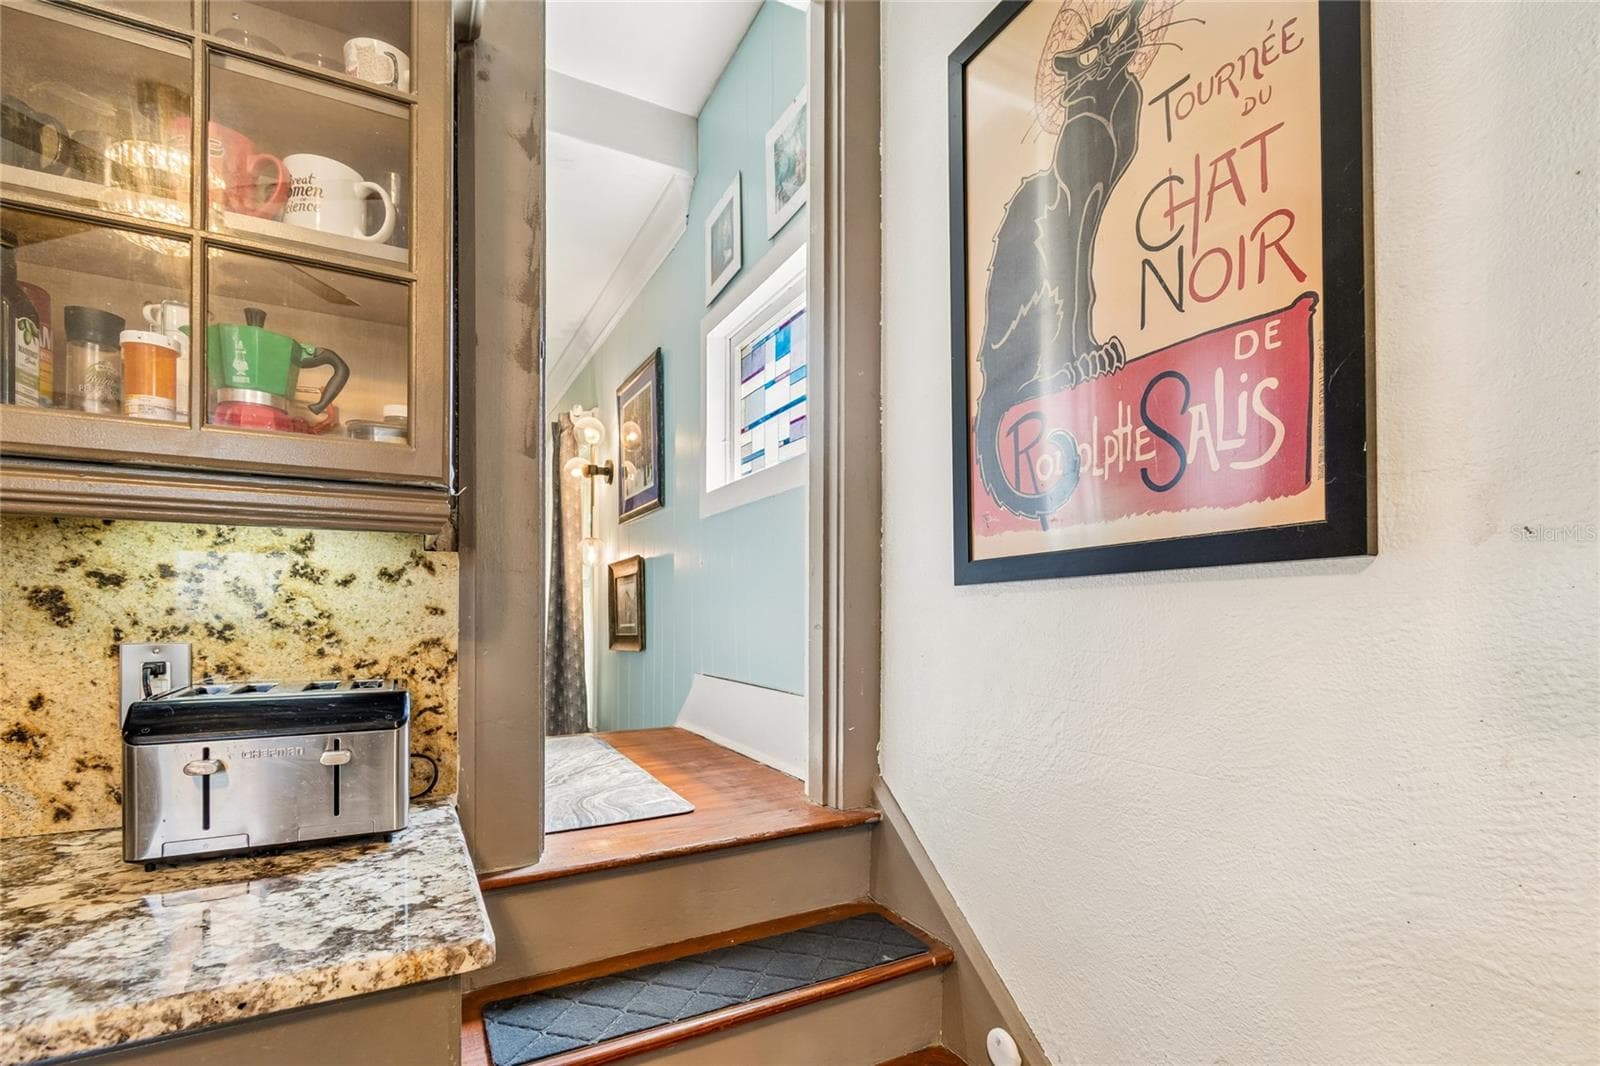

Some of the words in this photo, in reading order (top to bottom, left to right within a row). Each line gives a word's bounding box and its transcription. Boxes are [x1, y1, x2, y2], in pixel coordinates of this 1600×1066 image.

[1241, 85, 1272, 116] DU
[289, 173, 316, 185] reat
[1136, 122, 1285, 259] CHAT
[1140, 208, 1307, 330] NOIR
[1234, 319, 1282, 360] DE
